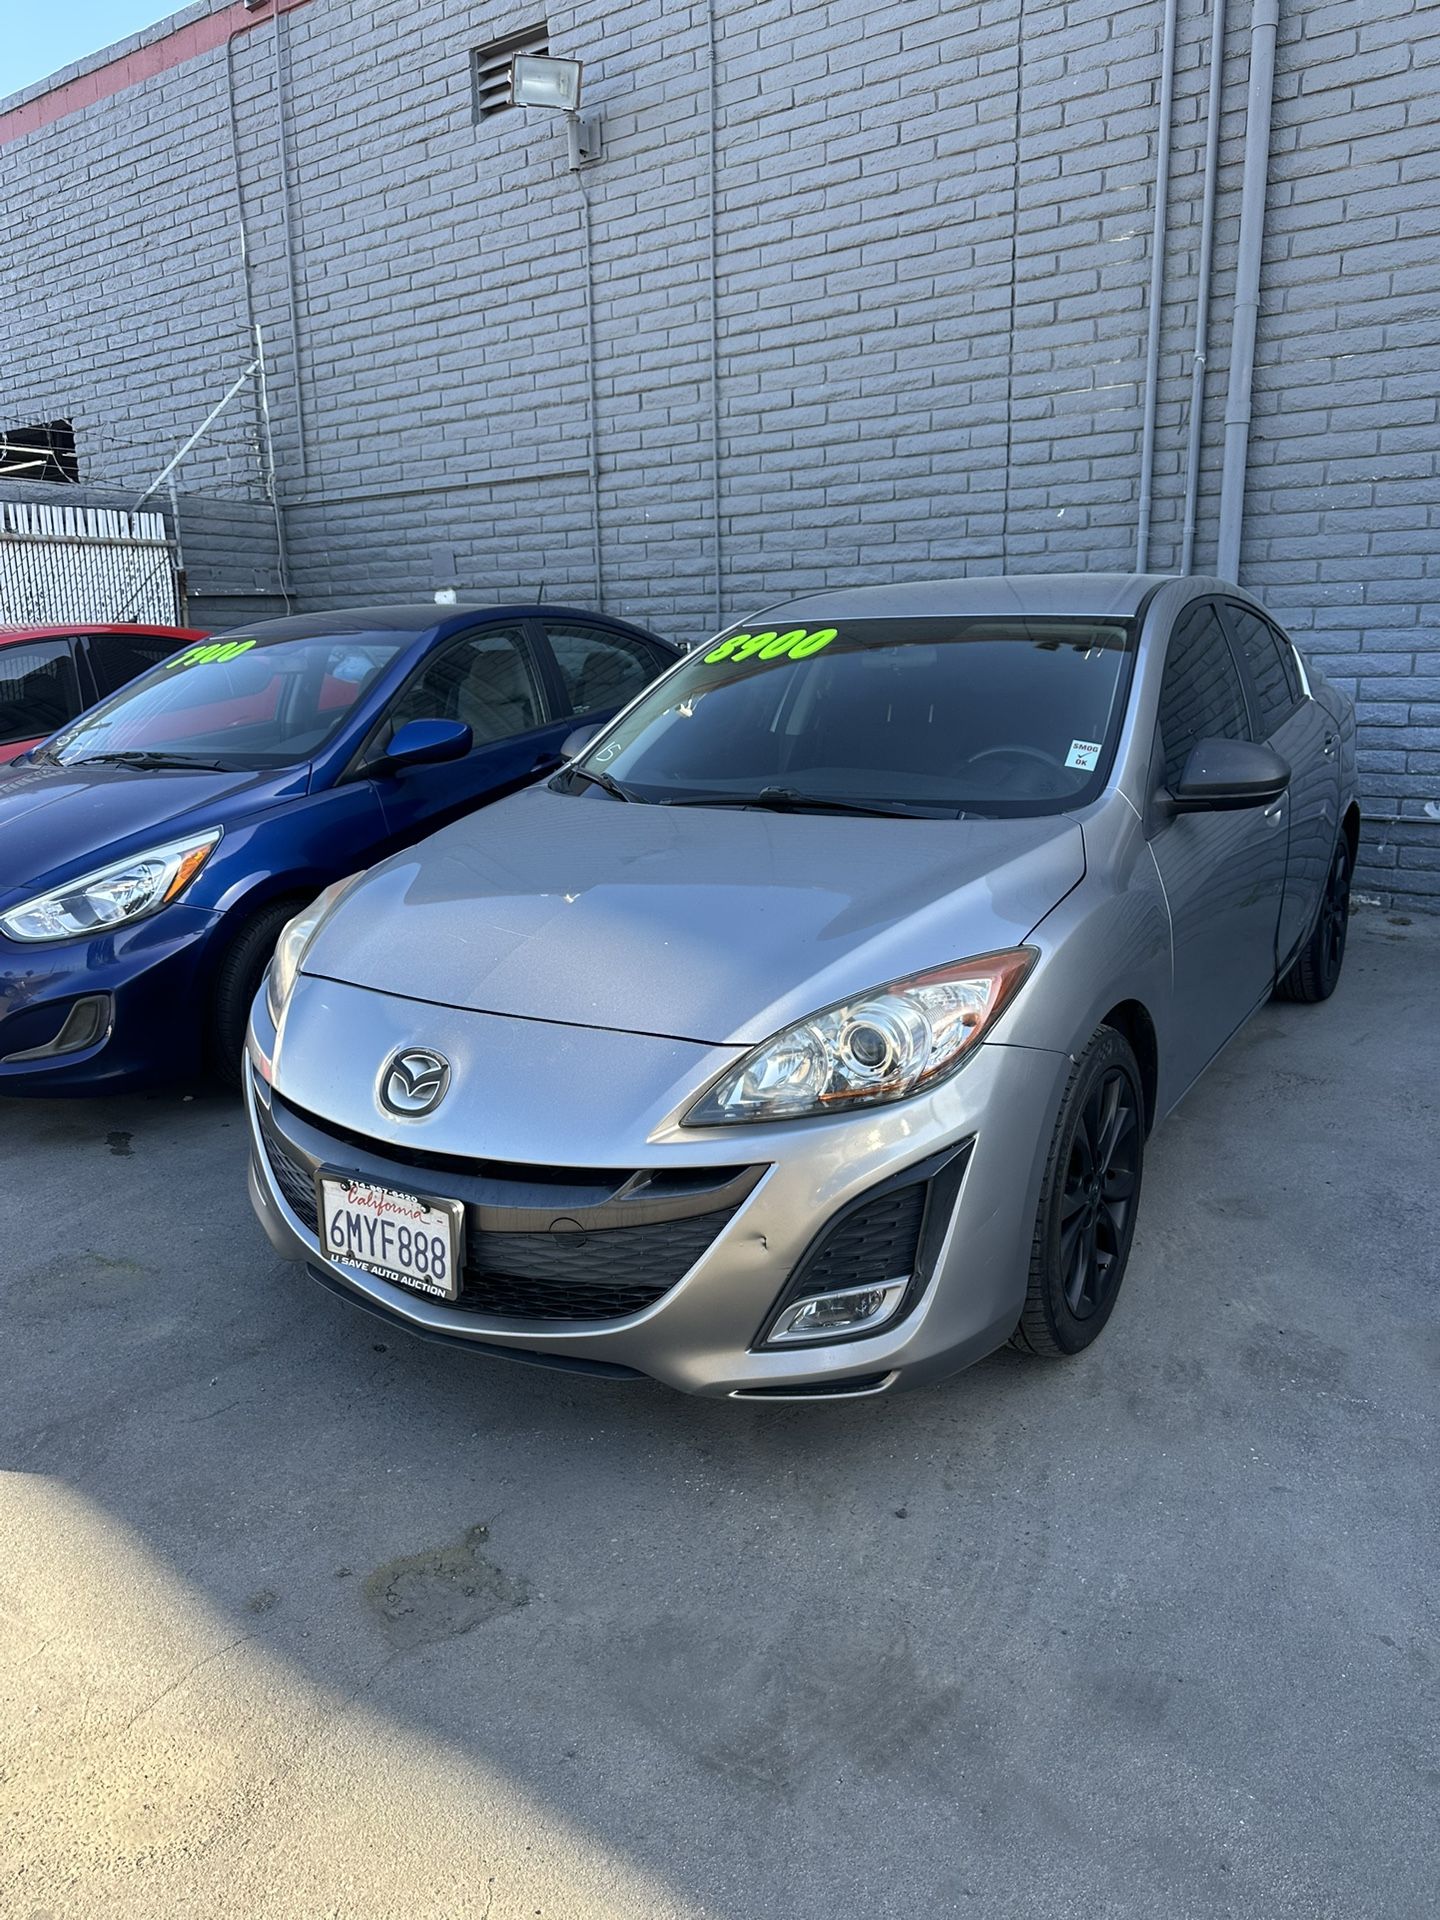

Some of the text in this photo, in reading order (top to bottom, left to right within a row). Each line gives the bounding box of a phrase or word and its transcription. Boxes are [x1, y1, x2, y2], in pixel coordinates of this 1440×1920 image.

[704, 628, 838, 664] 8900
[1073, 743, 1099, 752] SMOG
[1075, 758, 1087, 766] OK
[346, 1186, 431, 1225] California
[330, 1209, 446, 1280] 6MYF888
[330, 1254, 446, 1298] U SAVE AUTO AUCTION
